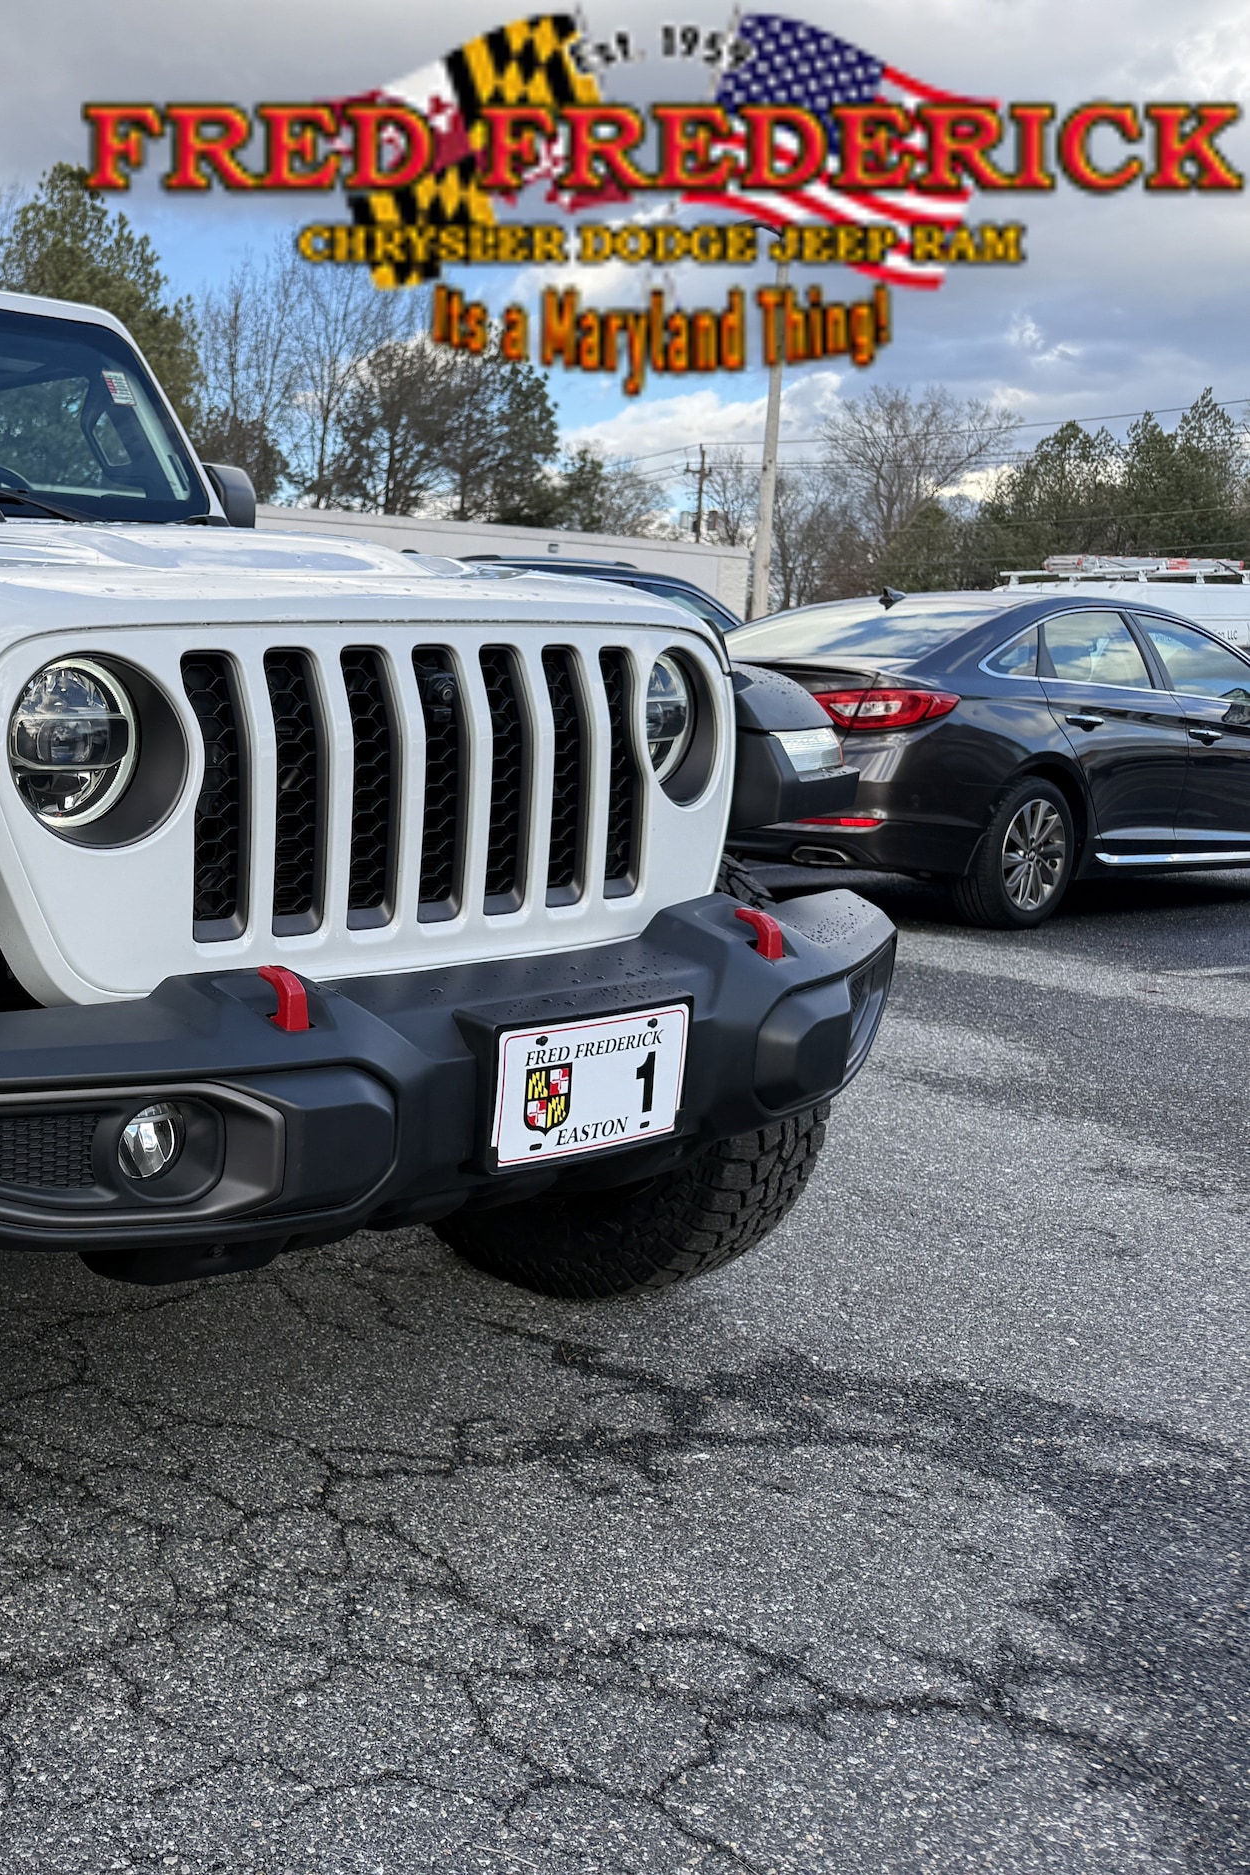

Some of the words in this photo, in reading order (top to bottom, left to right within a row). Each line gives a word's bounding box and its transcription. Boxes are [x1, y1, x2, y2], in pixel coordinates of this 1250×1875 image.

[525, 1046, 570, 1067] FRED
[574, 1029, 664, 1059] FREDERICK
[636, 1051, 656, 1113] 1
[555, 1117, 629, 1147] EASTON
